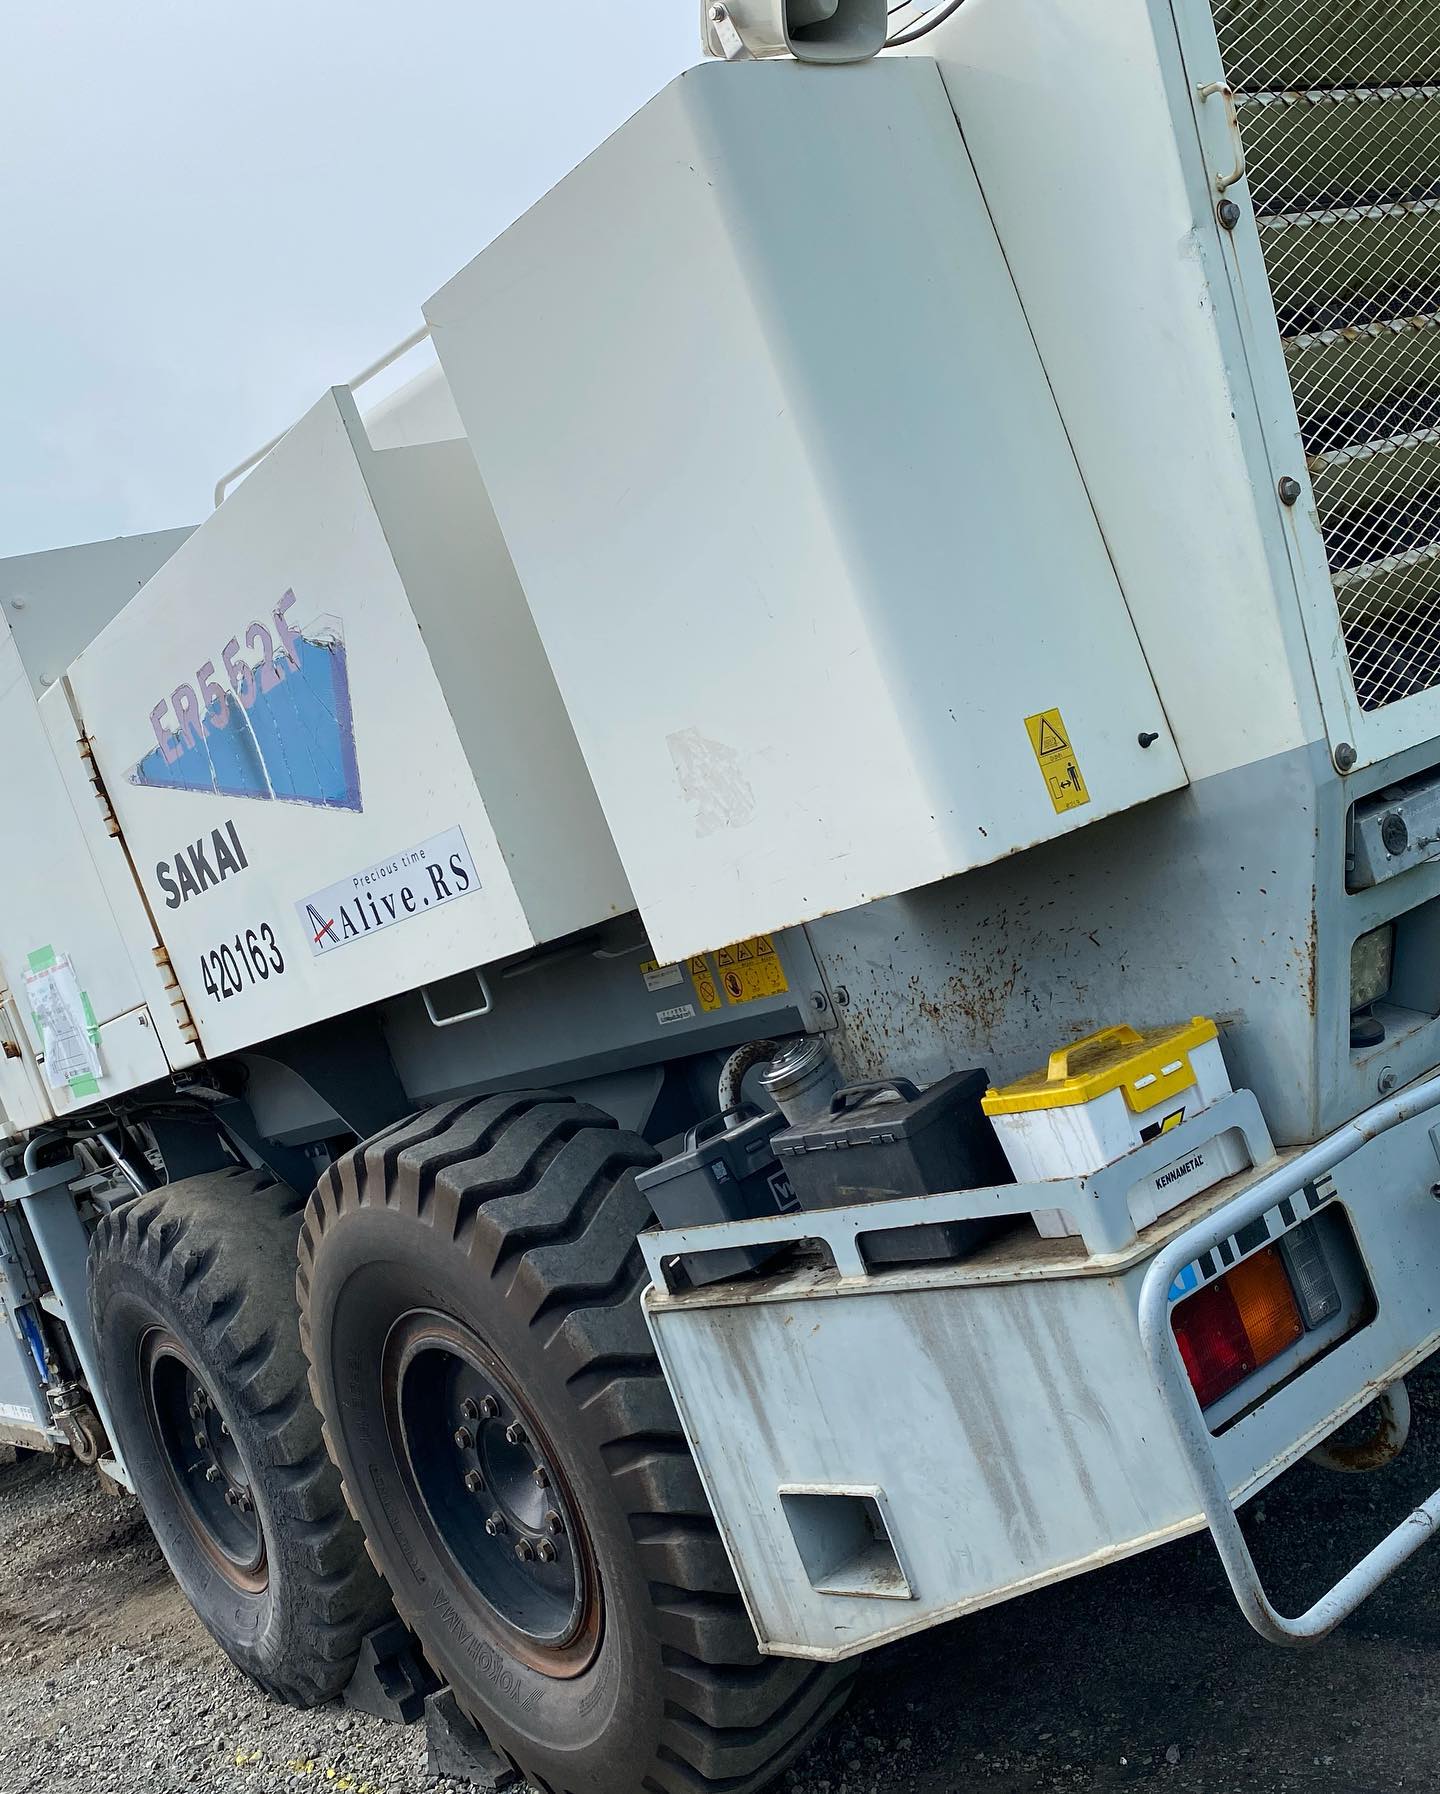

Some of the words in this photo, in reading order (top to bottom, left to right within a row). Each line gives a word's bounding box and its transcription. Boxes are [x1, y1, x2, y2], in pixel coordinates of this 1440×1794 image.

[156, 820, 249, 909] SAKAI
[339, 853, 469, 939] Alive.RS
[353, 861, 398, 888] Precious
[401, 849, 426, 867] time
[200, 922, 284, 1002] 420163
[1155, 1155, 1204, 1190] KENNAMETAL
[432, 1588, 522, 1704] YOKOHAMA
